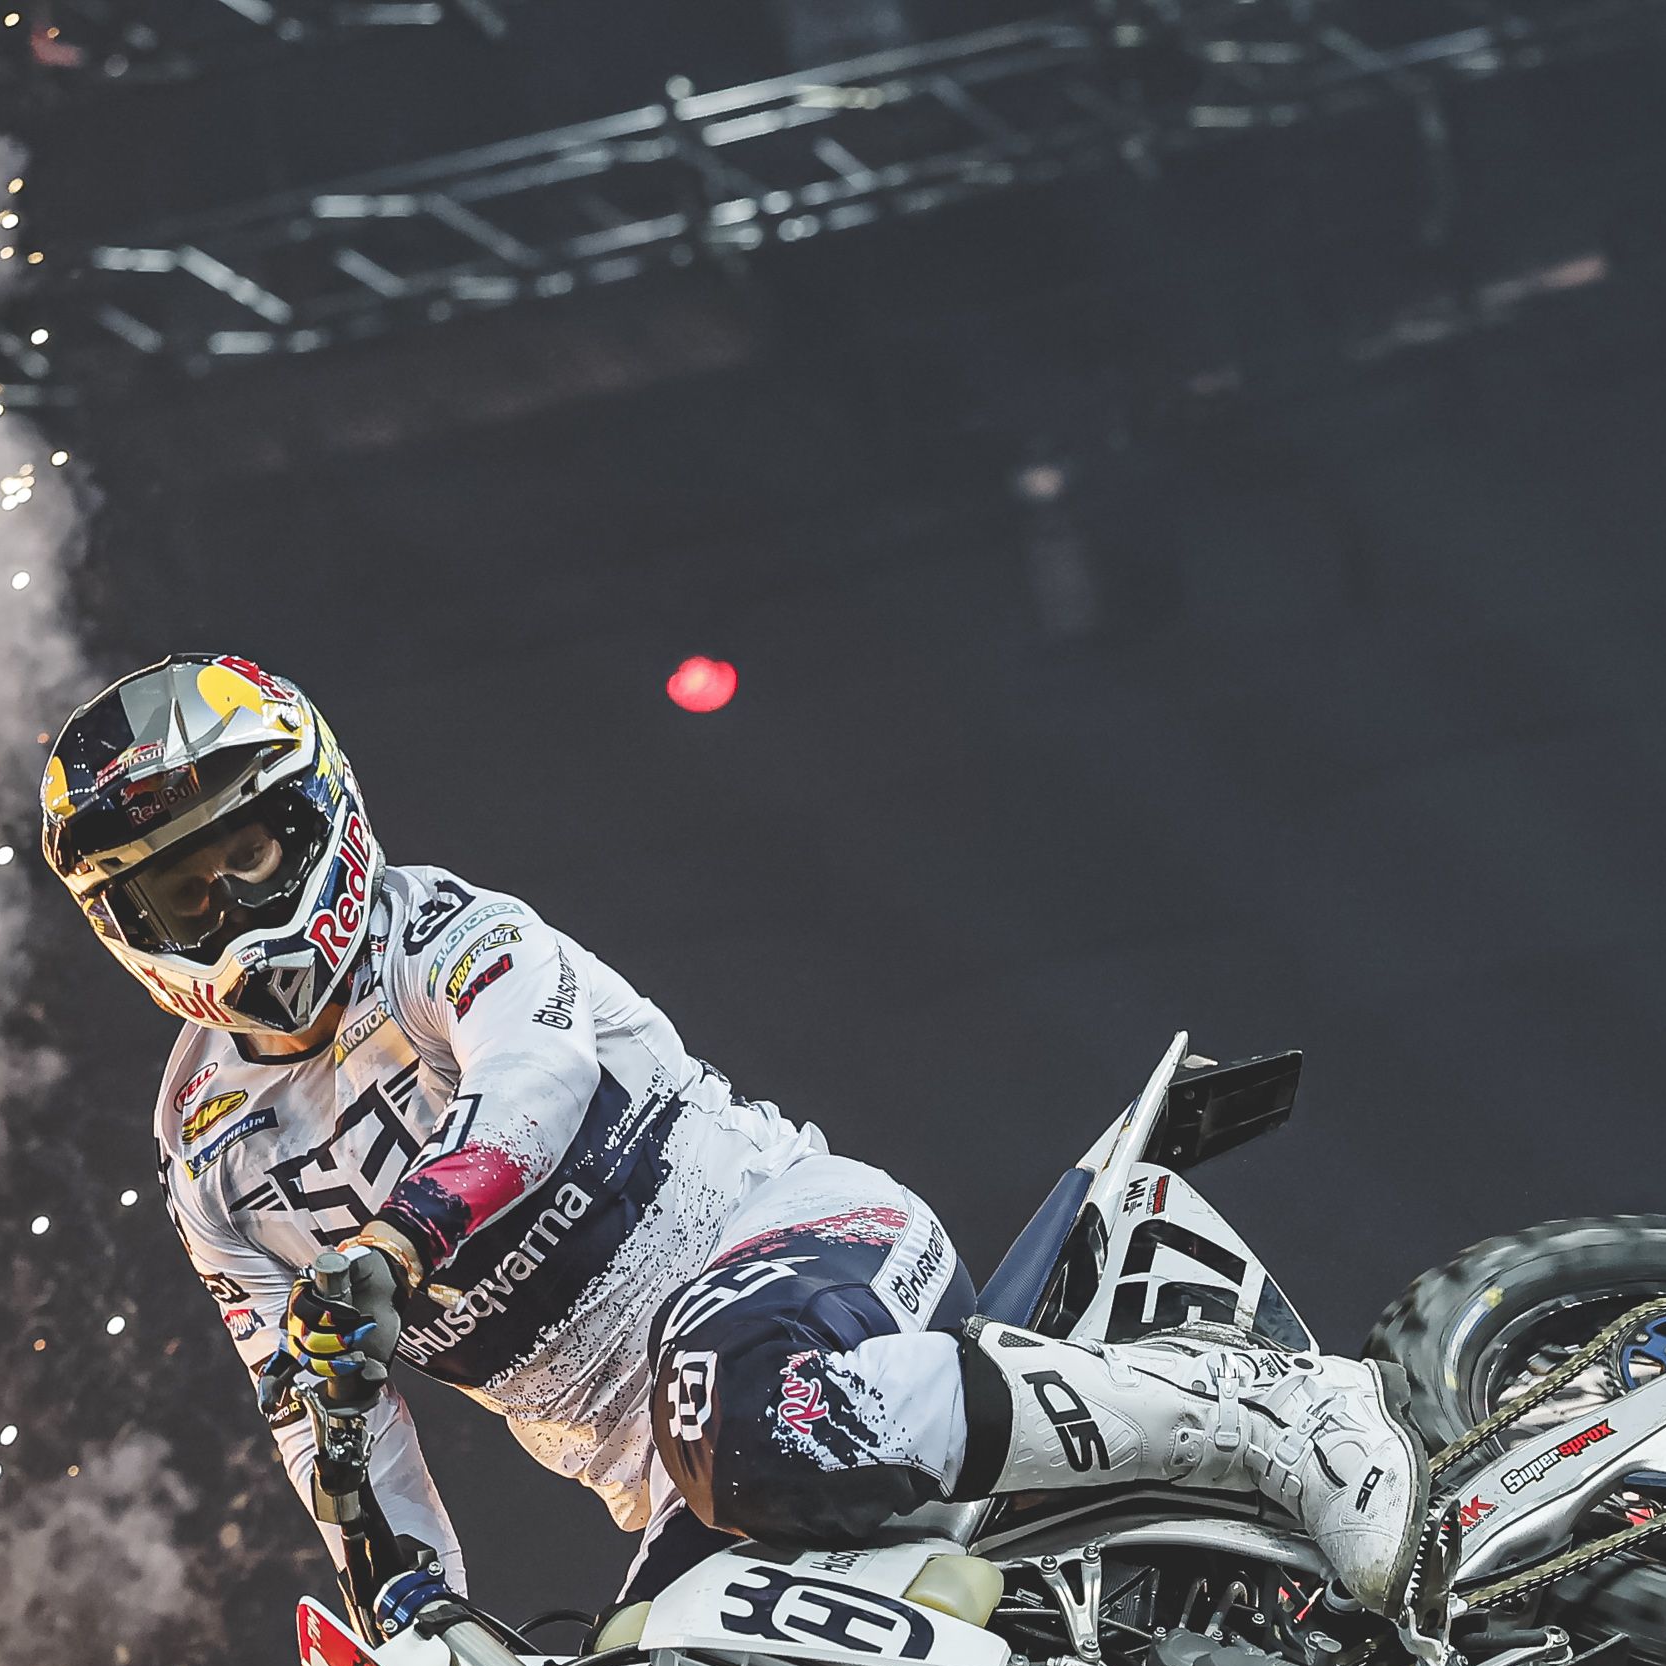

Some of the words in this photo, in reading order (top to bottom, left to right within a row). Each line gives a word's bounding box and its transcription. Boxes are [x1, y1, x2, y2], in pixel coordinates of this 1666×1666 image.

[306, 846, 369, 970] Red
[209, 1116, 266, 1160] MICHELIN
[405, 1179, 594, 1357] Husqvarna
[1501, 1418, 1613, 1494] Supersprox
